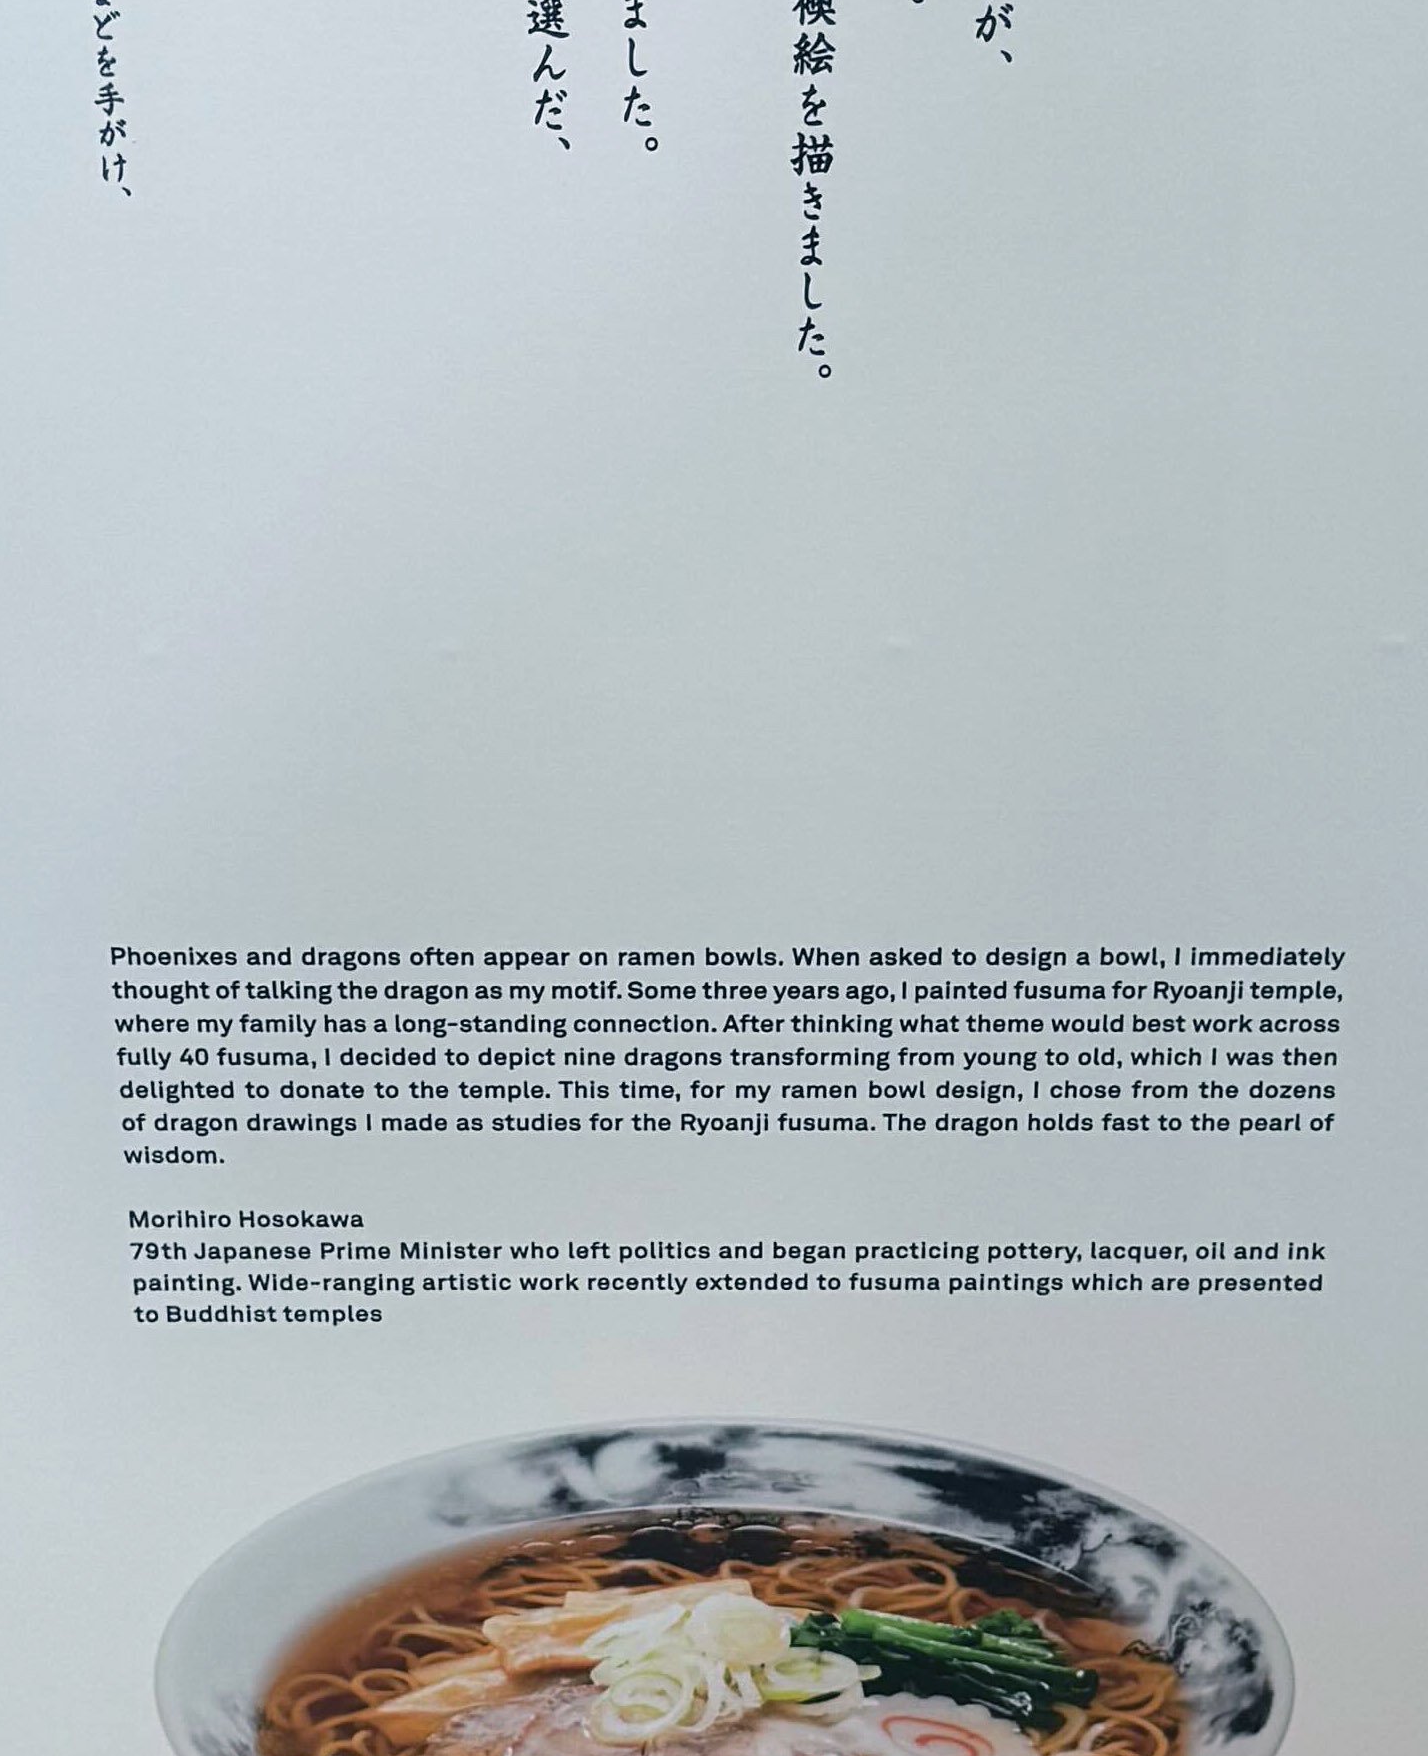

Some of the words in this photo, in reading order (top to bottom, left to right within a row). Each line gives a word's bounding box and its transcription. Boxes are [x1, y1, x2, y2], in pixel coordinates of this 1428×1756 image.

[110, 945, 238, 966] Phoenixes
[246, 946, 293, 967] and
[301, 946, 401, 972] dragons
[409, 946, 475, 967] often
[483, 951, 571, 971] appear
[578, 951, 608, 967] on
[617, 951, 695, 967] ramen
[705, 946, 784, 967] bowls.
[791, 946, 860, 967] When
[868, 946, 943, 967] asked
[951, 947, 977, 967] to
[985, 946, 1067, 972] design
[1075, 951, 1091, 967] a
[1099, 946, 1166, 970] bowl,
[1174, 946, 1181, 967] I
[1190, 946, 1347, 971] immediately
[111, 979, 211, 1006] thought
[215, 979, 241, 1000] of
[244, 980, 333, 1006] talking
[336, 979, 378, 1000] the
[383, 980, 469, 1006] dragon
[474, 985, 503, 1000] as
[509, 985, 546, 1005] my
[551, 979, 623, 1000] motif.
[627, 980, 697, 1000] Some
[701, 980, 768, 1000] three
[772, 984, 840, 1005] years
[845, 984, 896, 1006] ago,
[901, 980, 907, 1000] I
[914, 980, 1008, 1004] painted
[1012, 979, 1107, 1000] fusuma
[1111, 979, 1149, 1000] for
[1153, 979, 1244, 1005] Ryoanji
[1249, 980, 1343, 1004] temple,
[114, 1013, 190, 1034] where
[196, 1018, 234, 1038] my
[238, 1013, 318, 1038] family
[323, 1013, 367, 1034] has
[373, 1018, 388, 1033] a
[394, 1013, 568, 1039] long-standing
[573, 1013, 718, 1034] connection.
[722, 1013, 786, 1034] After
[789, 1013, 894, 1039] thinking
[899, 1013, 960, 1034] what
[965, 1013, 1045, 1033] theme
[1051, 1013, 1125, 1033] would
[1132, 1013, 1187, 1033] best
[1192, 1013, 1254, 1034] work
[1258, 1018, 1340, 1034] across
[115, 1046, 172, 1071] fully
[179, 1047, 209, 1066] 40
[215, 1046, 317, 1070] fusuma,
[324, 1047, 331, 1067] I
[339, 1046, 437, 1067] decided
[443, 1048, 470, 1067] to
[477, 1046, 556, 1071] depict
[563, 1046, 616, 1067] nine
[623, 1046, 723, 1072] dragons
[729, 1046, 891, 1072] transforming
[897, 1046, 955, 1067] from
[962, 1050, 1038, 1072] young
[1044, 1048, 1070, 1067] to
[1077, 1046, 1123, 1070] old,
[1130, 1046, 1202, 1067] which
[1211, 1047, 1217, 1067] I
[1225, 1051, 1274, 1067] was
[1281, 1046, 1338, 1067] then
[119, 1079, 235, 1104] delighted
[244, 1081, 270, 1099] to
[279, 1079, 365, 1099] donate
[373, 1081, 400, 1099] to
[408, 1079, 449, 1099] the
[457, 1079, 551, 1104] temple.
[557, 1079, 610, 1099] This
[618, 1079, 681, 1103] time,
[689, 1079, 726, 1099] for
[735, 1084, 772, 1104] my
[781, 1084, 857, 1099] ramen
[868, 1079, 926, 1099] bowl
[935, 1079, 1024, 1105] design,
[1033, 1080, 1040, 1099] I
[1049, 1079, 1122, 1099] chose
[1130, 1079, 1189, 1099] from
[1197, 1079, 1240, 1099] the
[1248, 1079, 1336, 1100] dozens
[121, 1112, 147, 1132] of
[153, 1112, 238, 1138] dragon
[246, 1112, 358, 1137] drawings
[366, 1113, 372, 1132] I
[380, 1112, 448, 1132] made
[455, 1117, 484, 1132] as
[491, 1112, 582, 1132] studies
[588, 1112, 625, 1132] for
[630, 1112, 672, 1132] the
[680, 1112, 769, 1137] Ryoanji
[776, 1112, 876, 1132] fusuma.
[881, 1112, 927, 1132] The
[934, 1112, 1019, 1137] dragon
[1027, 1112, 1094, 1132] holds
[1100, 1112, 1151, 1132] fast
[1157, 1114, 1183, 1132] to
[1189, 1112, 1231, 1132] the
[1239, 1112, 1302, 1137] pearl
[1309, 1112, 1336, 1132] of
[123, 1145, 225, 1165] wisdom.
[128, 1209, 232, 1229] Morihiro
[238, 1209, 365, 1229] Hosokawa
[129, 1241, 188, 1261] 79th
[193, 1241, 312, 1265] Japanese
[320, 1241, 391, 1261] Prime
[399, 1241, 503, 1260] Minister
[509, 1241, 560, 1260] who
[568, 1241, 611, 1260] left
[618, 1241, 711, 1264] politics
[718, 1240, 764, 1260] and
[772, 1241, 846, 1265] began
[855, 1240, 980, 1265] practicing
[987, 1242, 1083, 1265] pottery,
[1090, 1241, 1188, 1264] lacquer,
[1195, 1241, 1226, 1261] oil
[1233, 1241, 1279, 1261] and
[1287, 1241, 1326, 1261] ink
[132, 1273, 242, 1297] painting.
[247, 1273, 416, 1297] Wide-ranging
[422, 1272, 512, 1291] artistic
[518, 1272, 580, 1291] work
[587, 1272, 689, 1296] recently
[695, 1272, 809, 1291] extended
[815, 1273, 842, 1291] to
[848, 1271, 941, 1291] fusuma
[948, 1272, 1064, 1297] paintings
[1071, 1272, 1143, 1291] which
[1150, 1277, 1191, 1292] are
[1198, 1273, 1323, 1296] presented
[133, 1305, 159, 1324] to
[165, 1304, 278, 1323] Buddhist
[282, 1304, 383, 1327] temples
